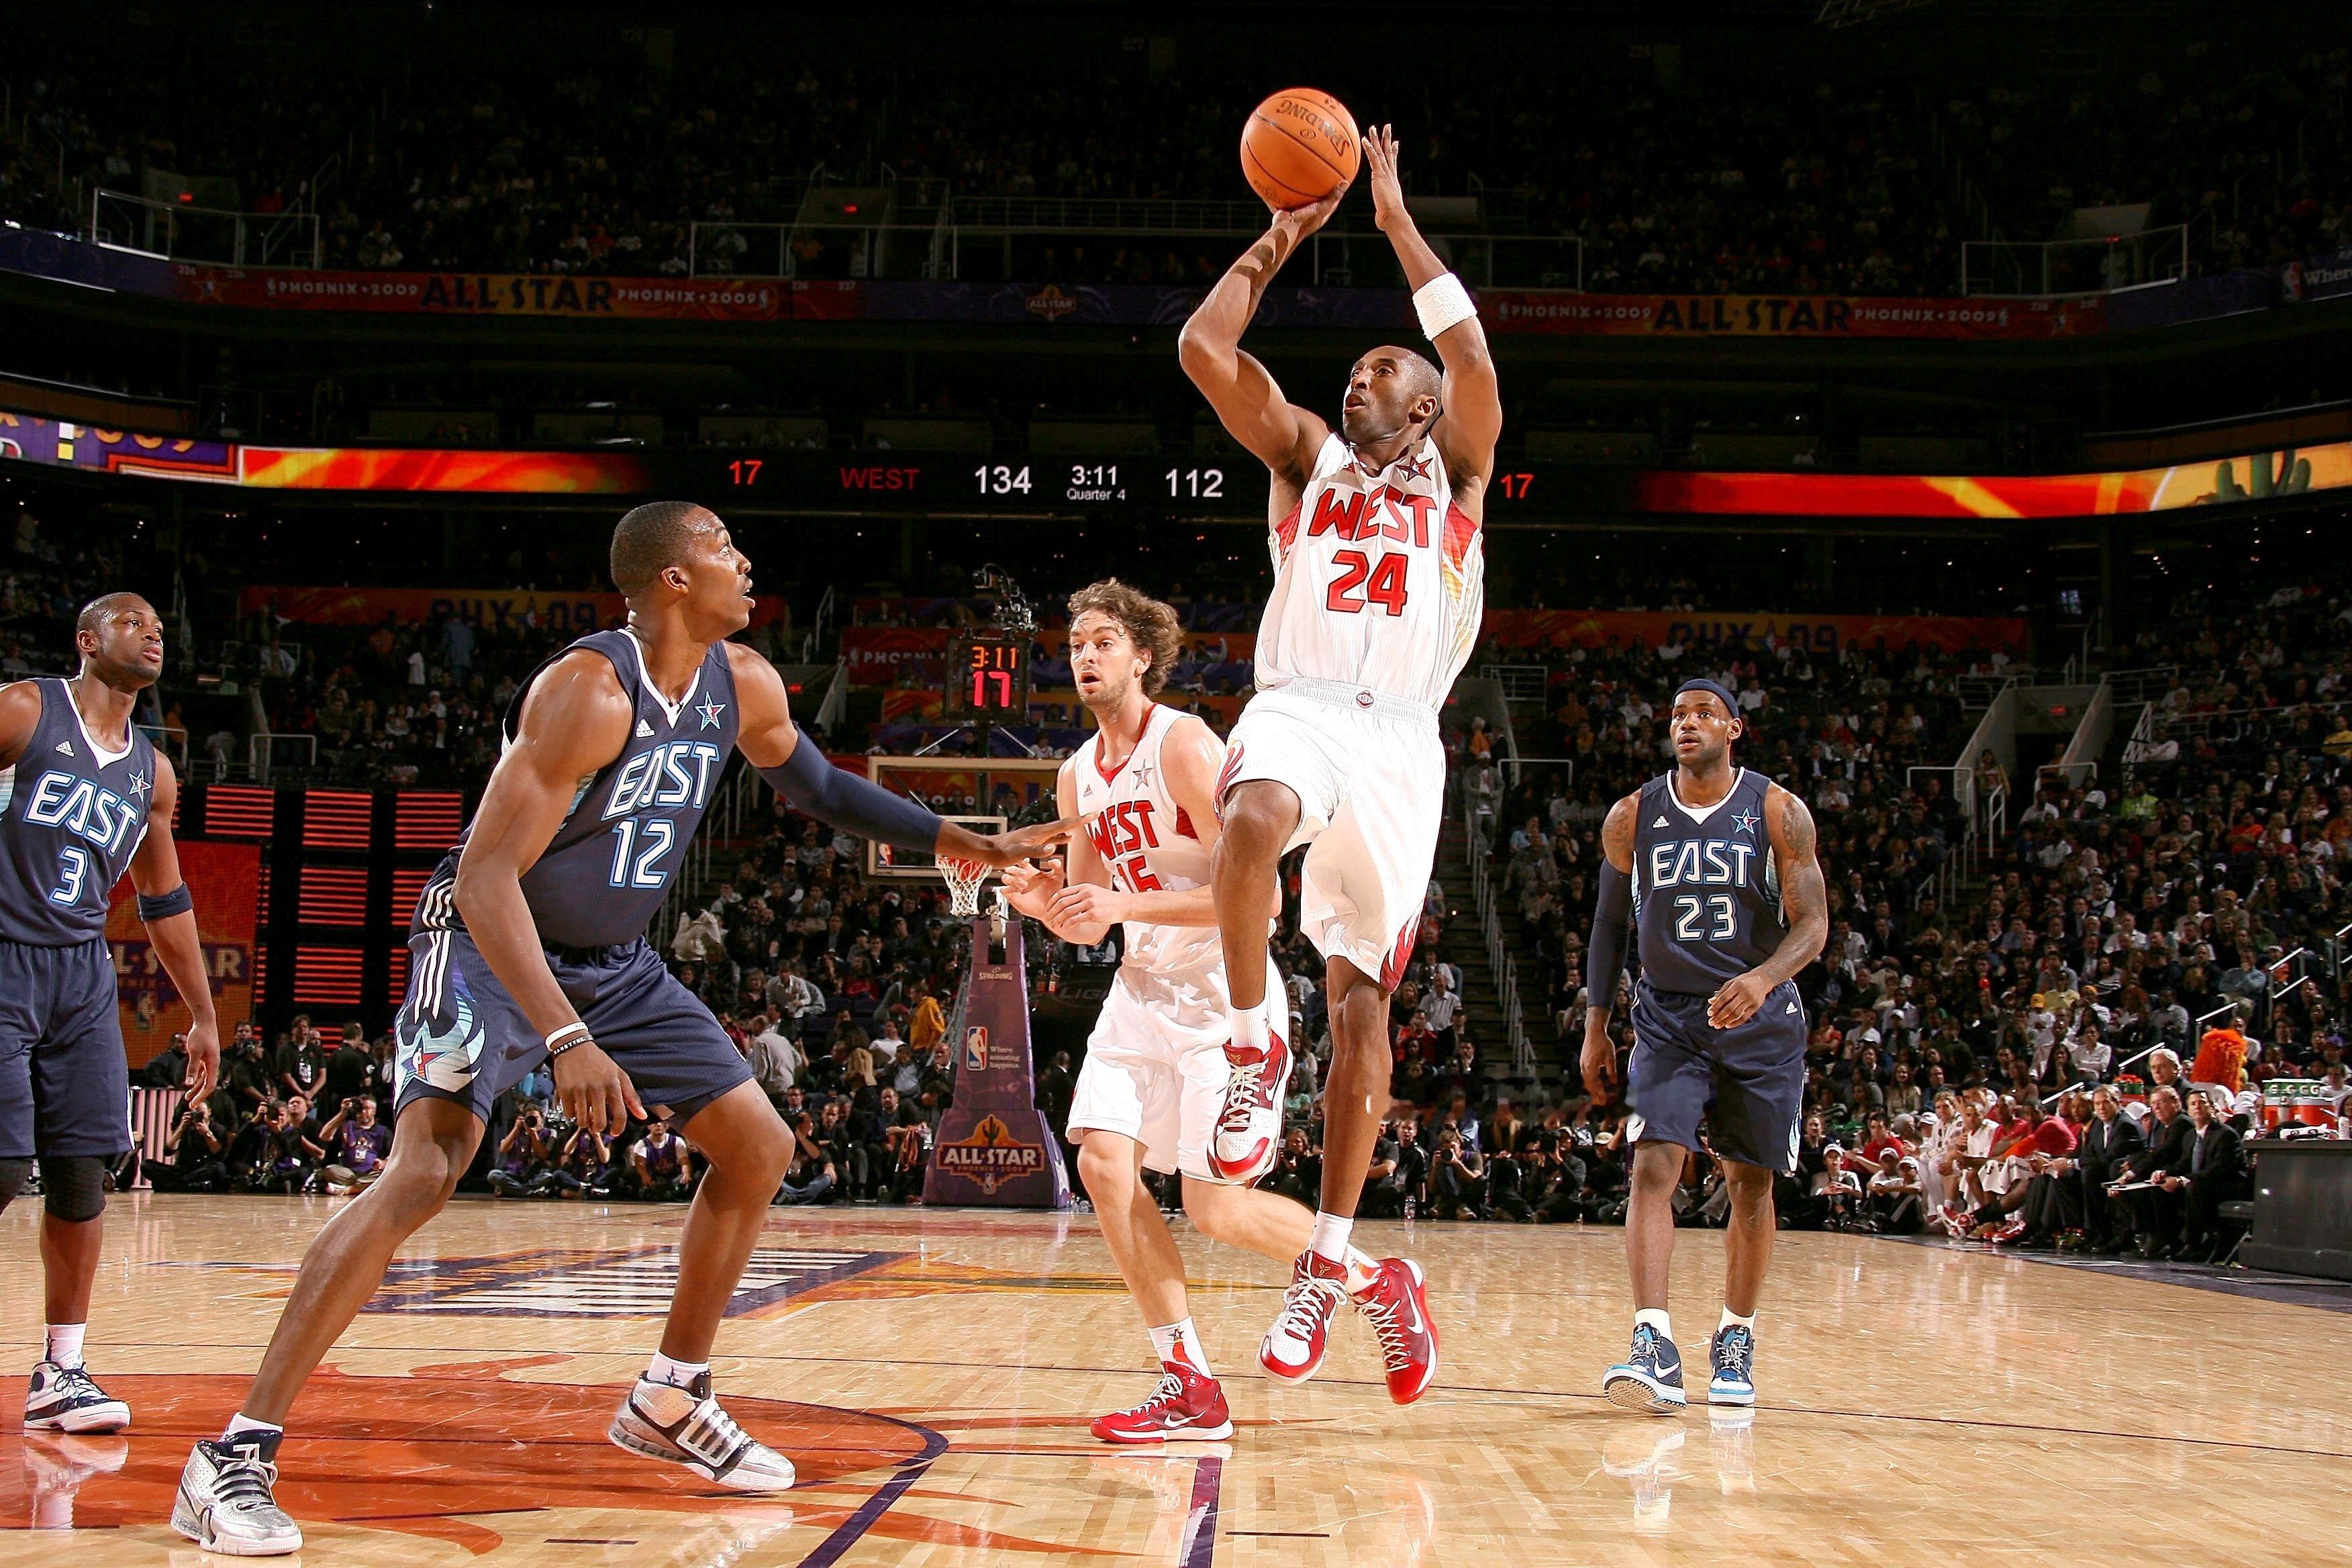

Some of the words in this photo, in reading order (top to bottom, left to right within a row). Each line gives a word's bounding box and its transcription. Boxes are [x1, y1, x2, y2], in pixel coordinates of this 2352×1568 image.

[1276, 99, 1350, 157] SPALDING
[279, 280, 358, 295] PHOENIX
[371, 282, 418, 297] 2009
[419, 276, 499, 309] ALL
[511, 277, 614, 313] STAR
[616, 289, 696, 303] PHOENIX
[708, 290, 757, 305] 2009
[1510, 302, 1590, 318] PHOENIX
[1604, 304, 1651, 319] 2009
[1652, 299, 1734, 331] ALL
[1746, 299, 1851, 332] STAR
[1854, 307, 1934, 322] PHOENIX
[1947, 307, 1996, 322] 2009
[728, 458, 763, 485] 17
[839, 466, 924, 490] WEST
[974, 465, 1033, 495] 134
[1071, 464, 1118, 486] 3:11
[1165, 468, 1224, 498] 112
[1499, 473, 1535, 500] 17
[1066, 488, 1113, 501] Quarter
[1117, 489, 1126, 501] 4
[1308, 483, 1438, 548] WEST
[1326, 549, 1408, 617] 24
[971, 644, 1018, 669] 3:11
[973, 671, 1012, 707] 17
[600, 740, 720, 821] EAST
[22, 769, 140, 857] EAST
[1086, 799, 1160, 861] WEST
[608, 817, 675, 889] 12
[1650, 839, 1757, 890] EAST
[49, 845, 89, 907] 3
[1674, 893, 1738, 941] 23
[979, 973, 1013, 981] SPALDING
[943, 1148, 983, 1165] ALL
[987, 1149, 1036, 1165] STAR
